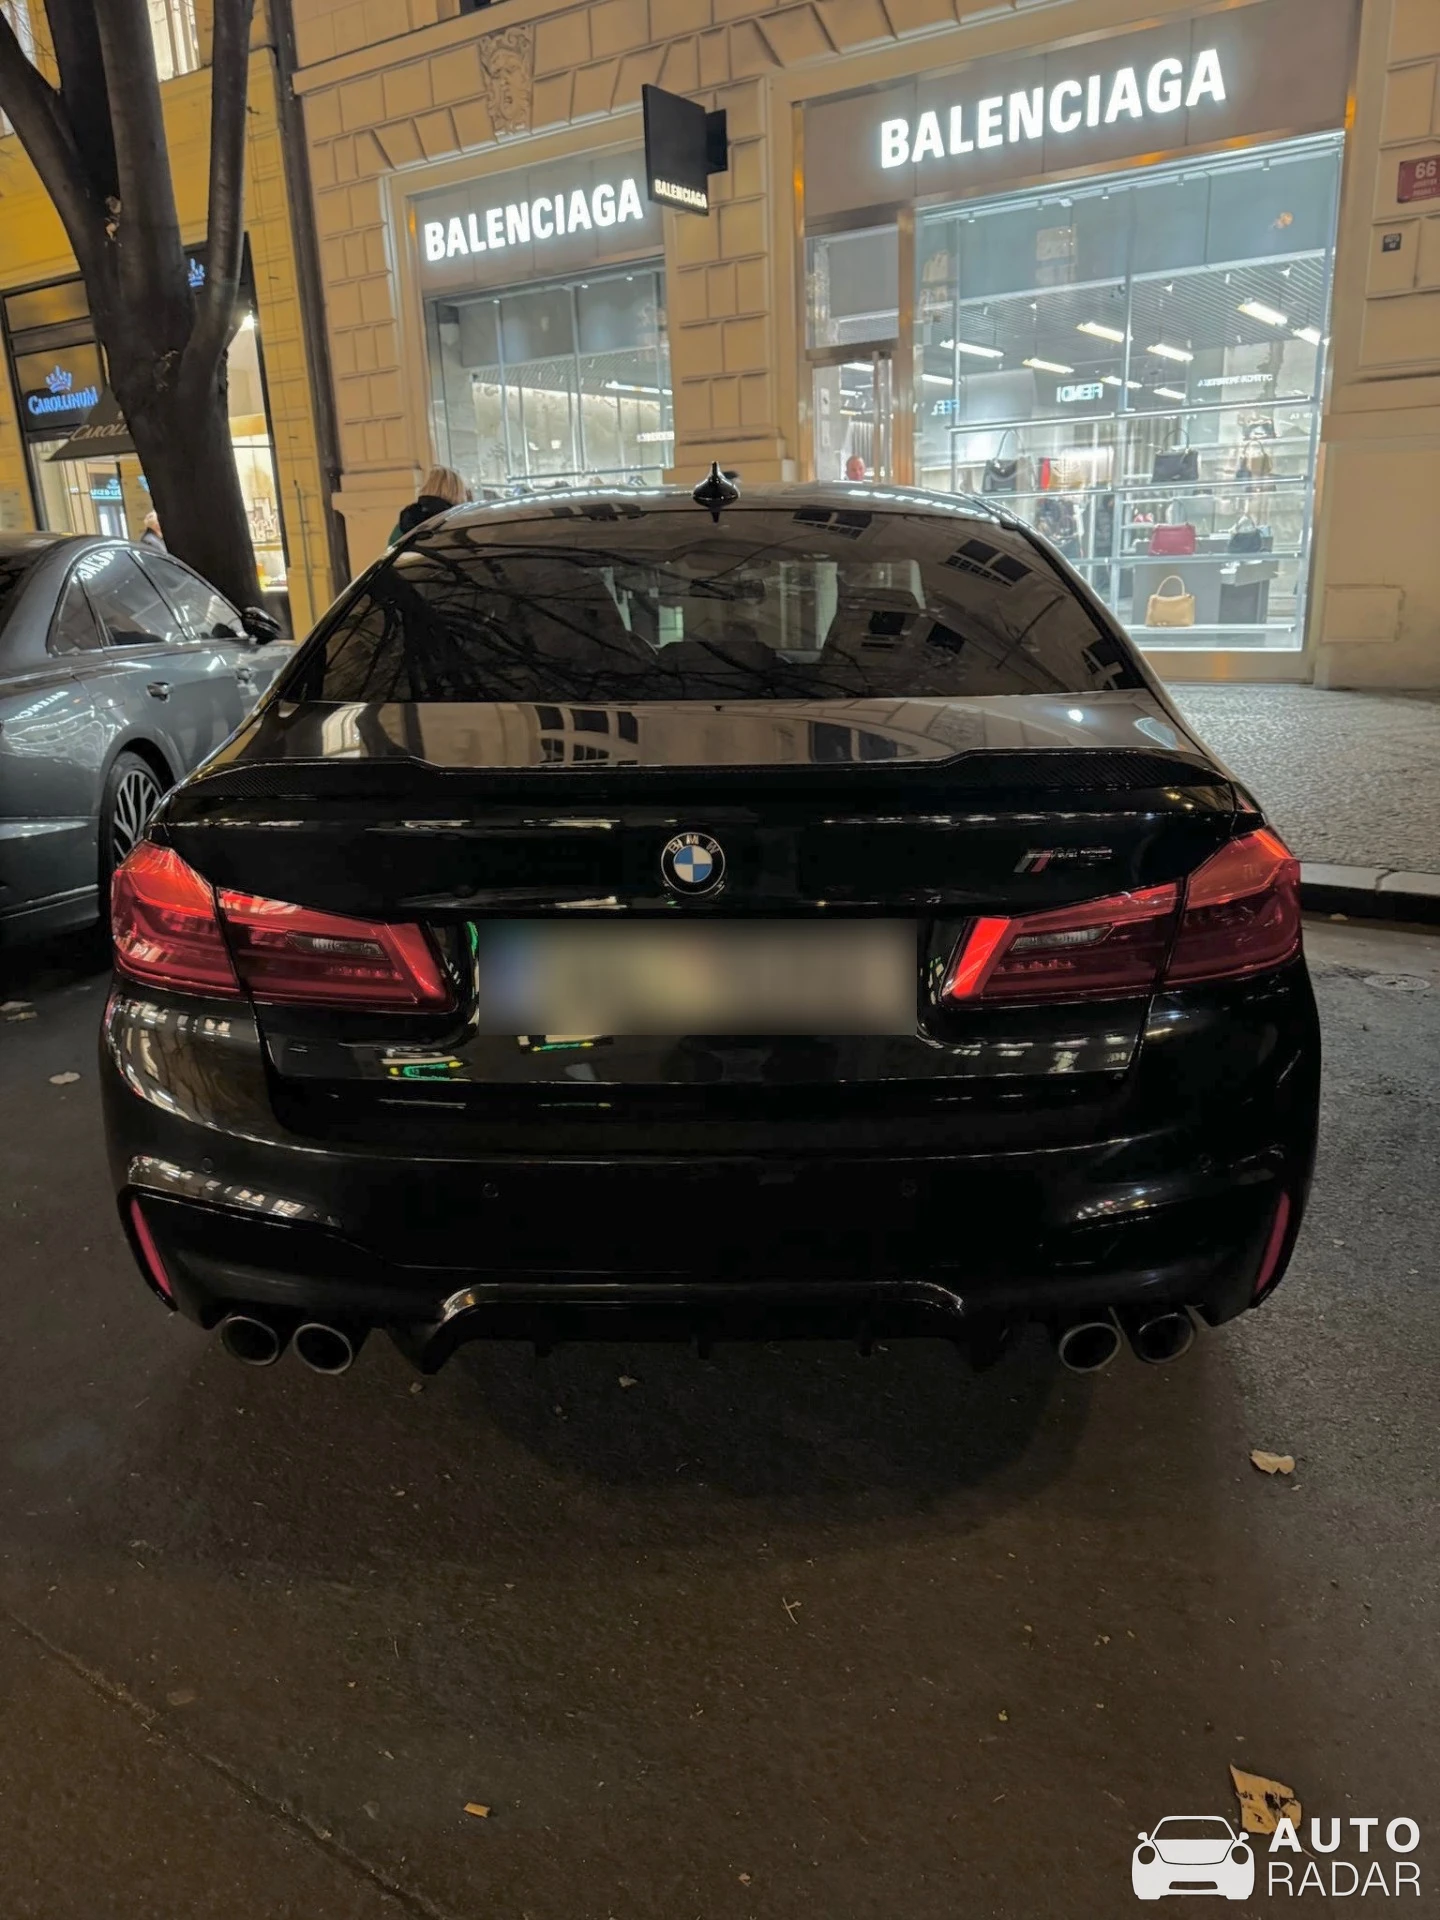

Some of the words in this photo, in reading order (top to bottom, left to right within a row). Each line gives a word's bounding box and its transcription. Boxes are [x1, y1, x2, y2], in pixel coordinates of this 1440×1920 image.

[881, 48, 1226, 169] BALENCIAGA
[1415, 160, 1437, 179] 66
[654, 178, 708, 209] BALENCIAGA
[424, 178, 643, 262] BALENCIAGA
[27, 385, 99, 416] CAROLLINUM
[70, 423, 130, 441] CAROLL
[667, 834, 720, 854] BMW
